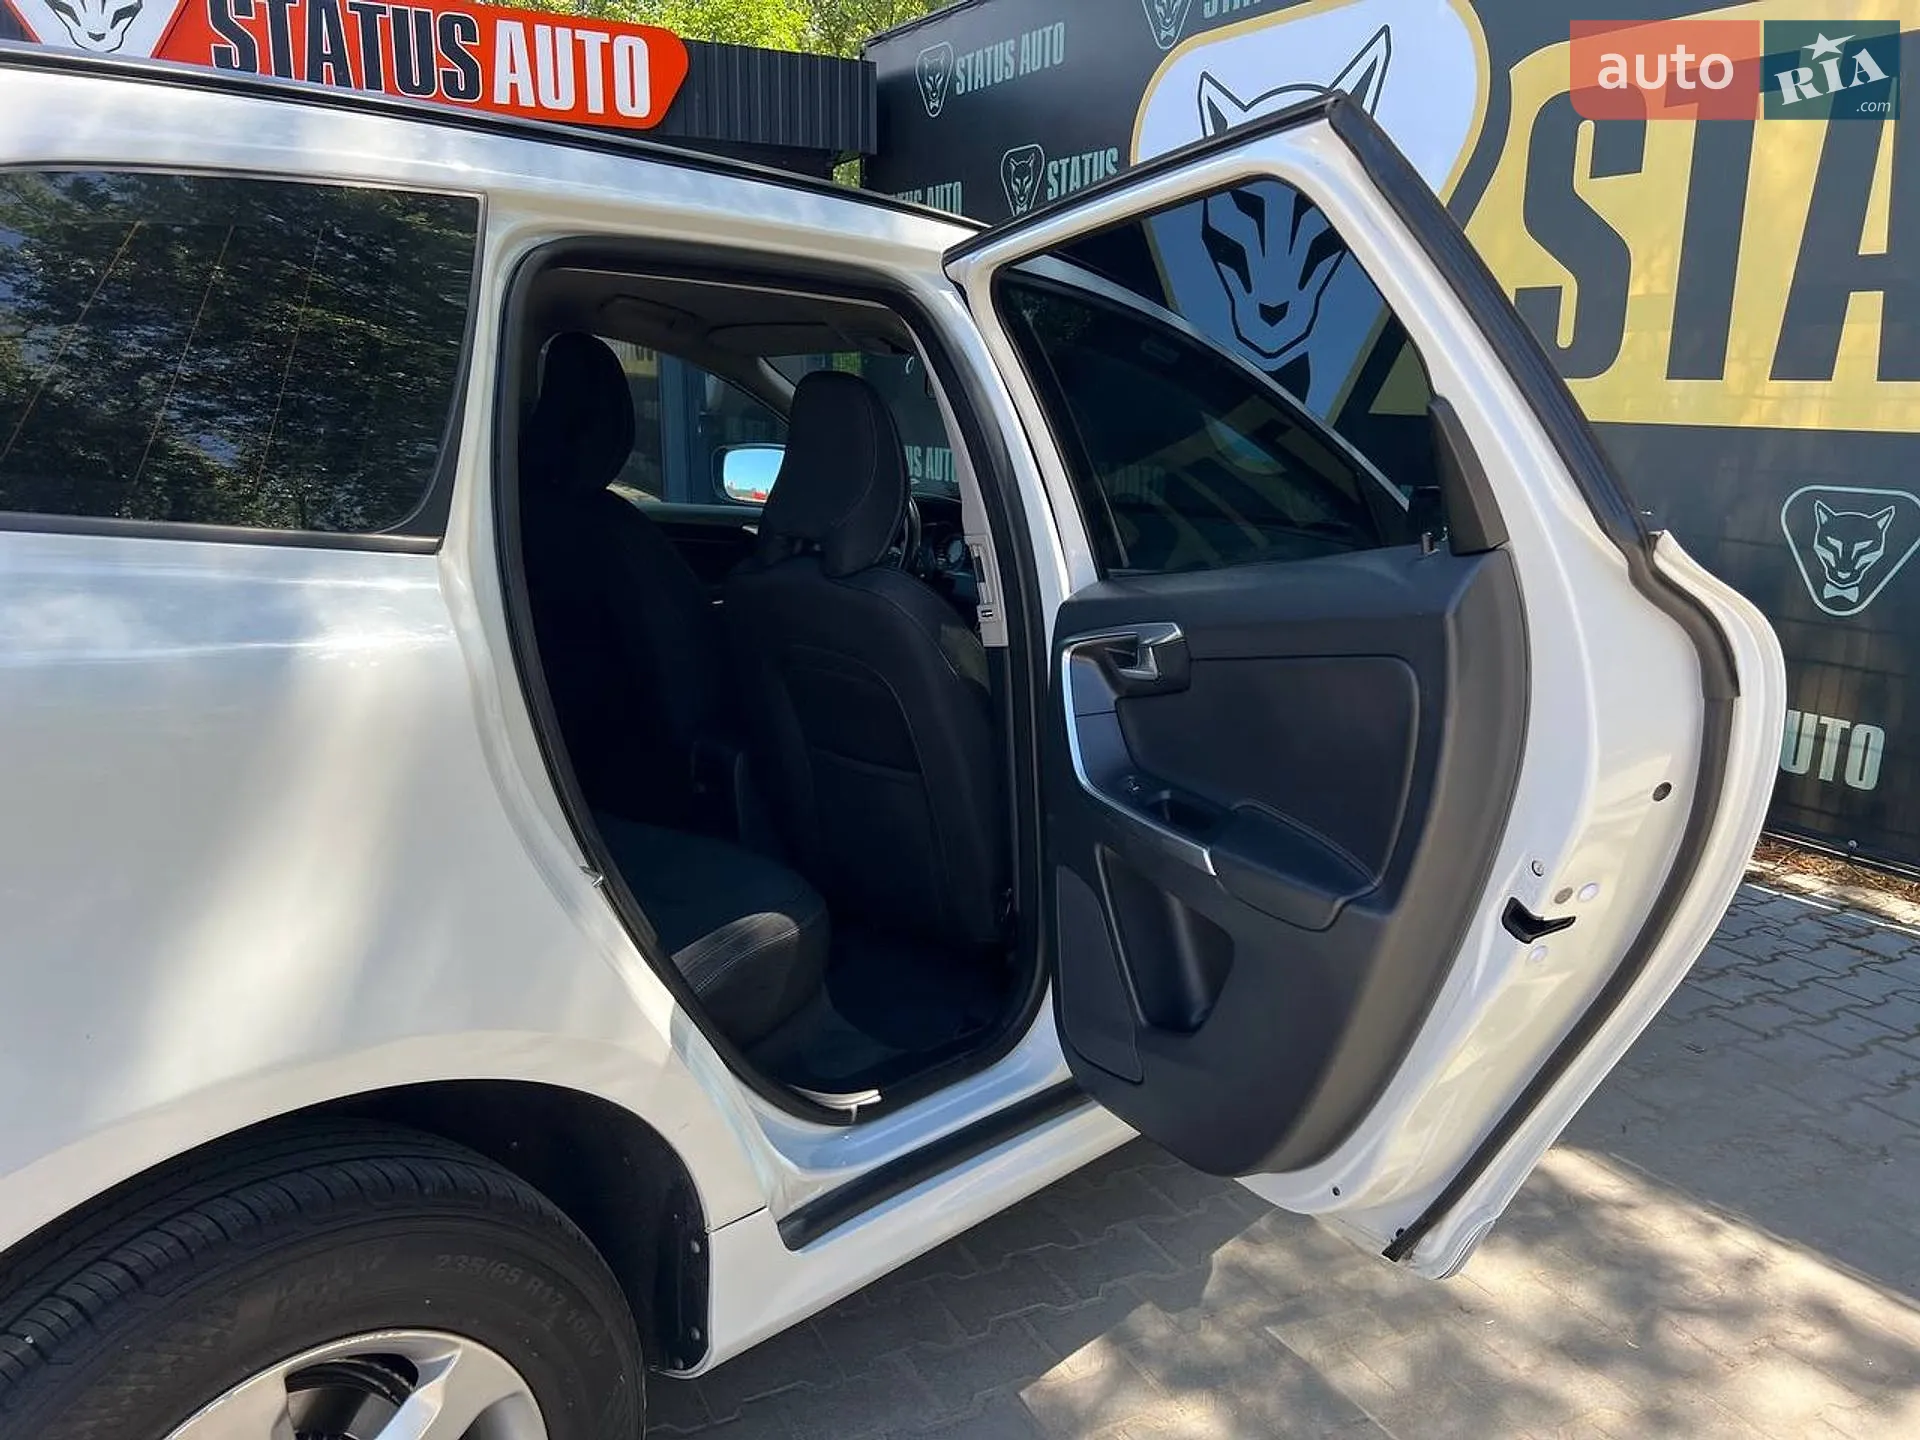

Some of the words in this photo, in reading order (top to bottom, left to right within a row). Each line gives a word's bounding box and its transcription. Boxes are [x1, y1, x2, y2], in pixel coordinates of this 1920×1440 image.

[208, 0, 482, 103] STATUS
[494, 19, 652, 118] AUTO
[956, 38, 1015, 96] STATUS
[1019, 21, 1065, 76] AUTO
[1047, 147, 1119, 201] STATUS
